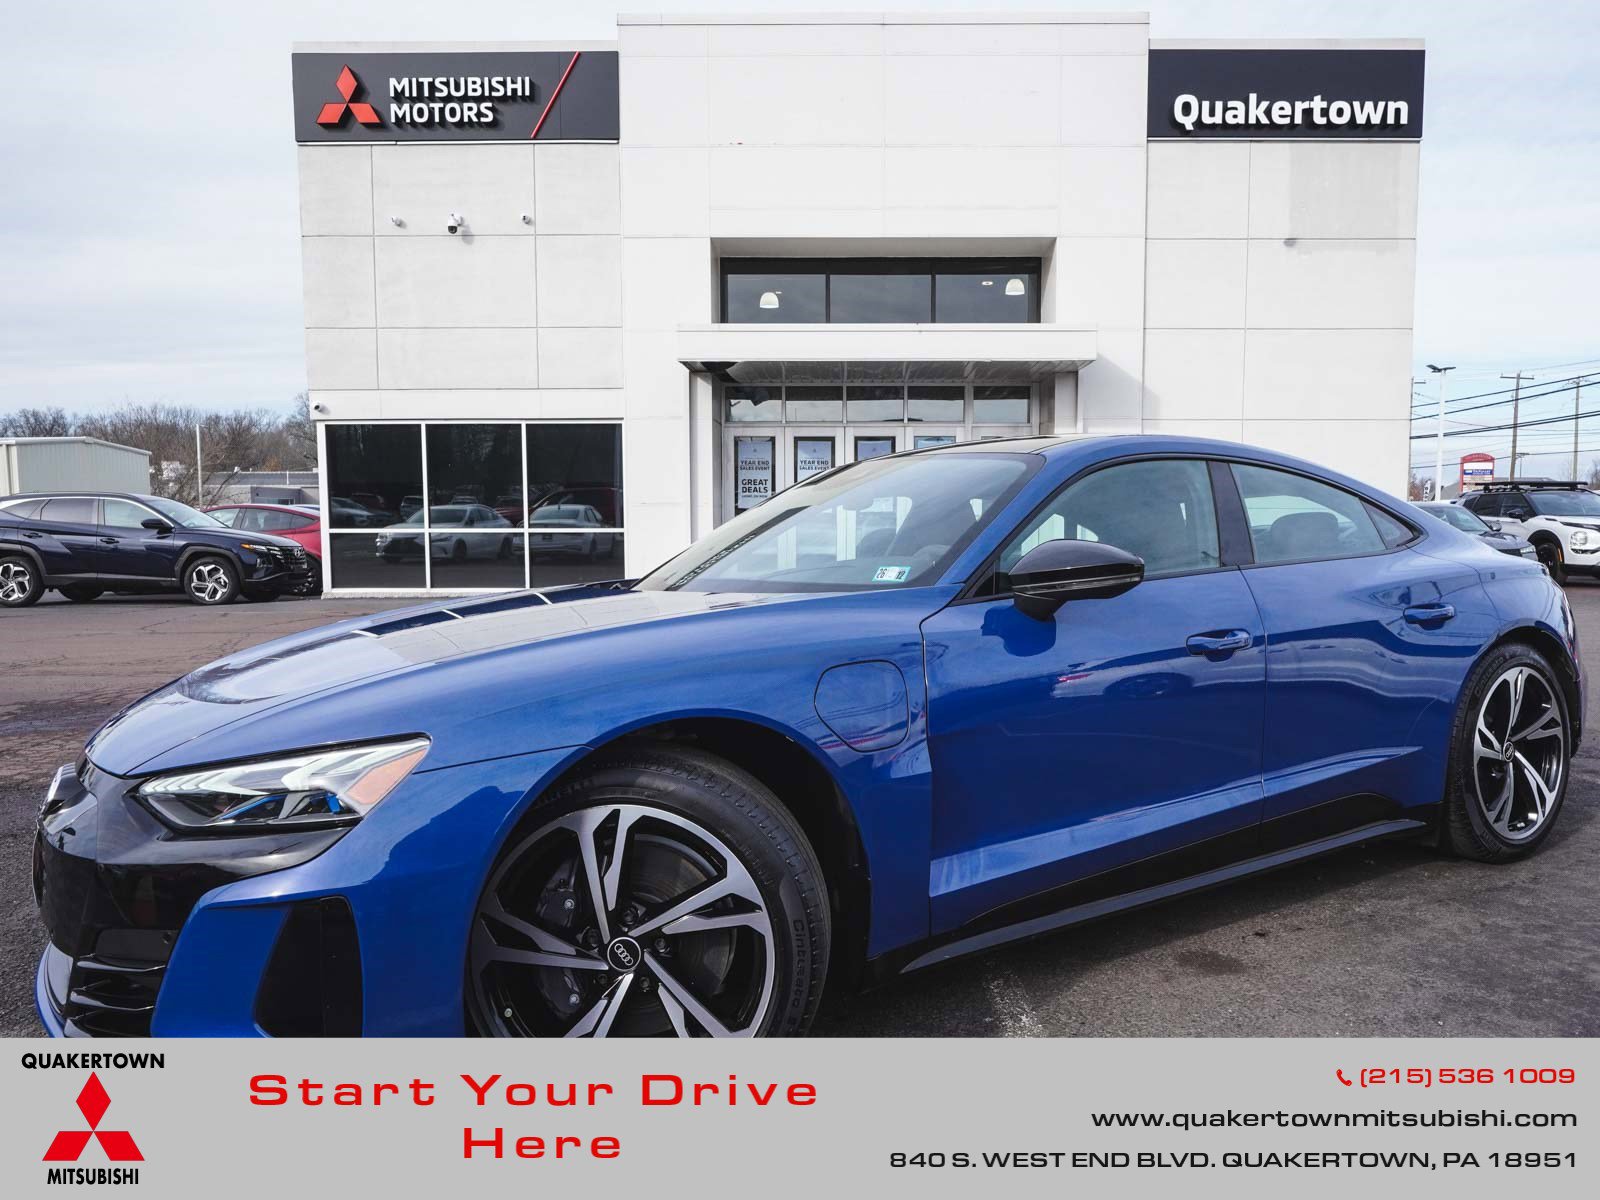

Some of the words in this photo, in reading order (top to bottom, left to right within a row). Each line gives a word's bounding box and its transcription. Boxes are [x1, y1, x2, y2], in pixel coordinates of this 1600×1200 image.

[389, 76, 530, 97] MITSUBISHI
[390, 102, 494, 123] MOTORS
[1174, 93, 1409, 131] Quakertown
